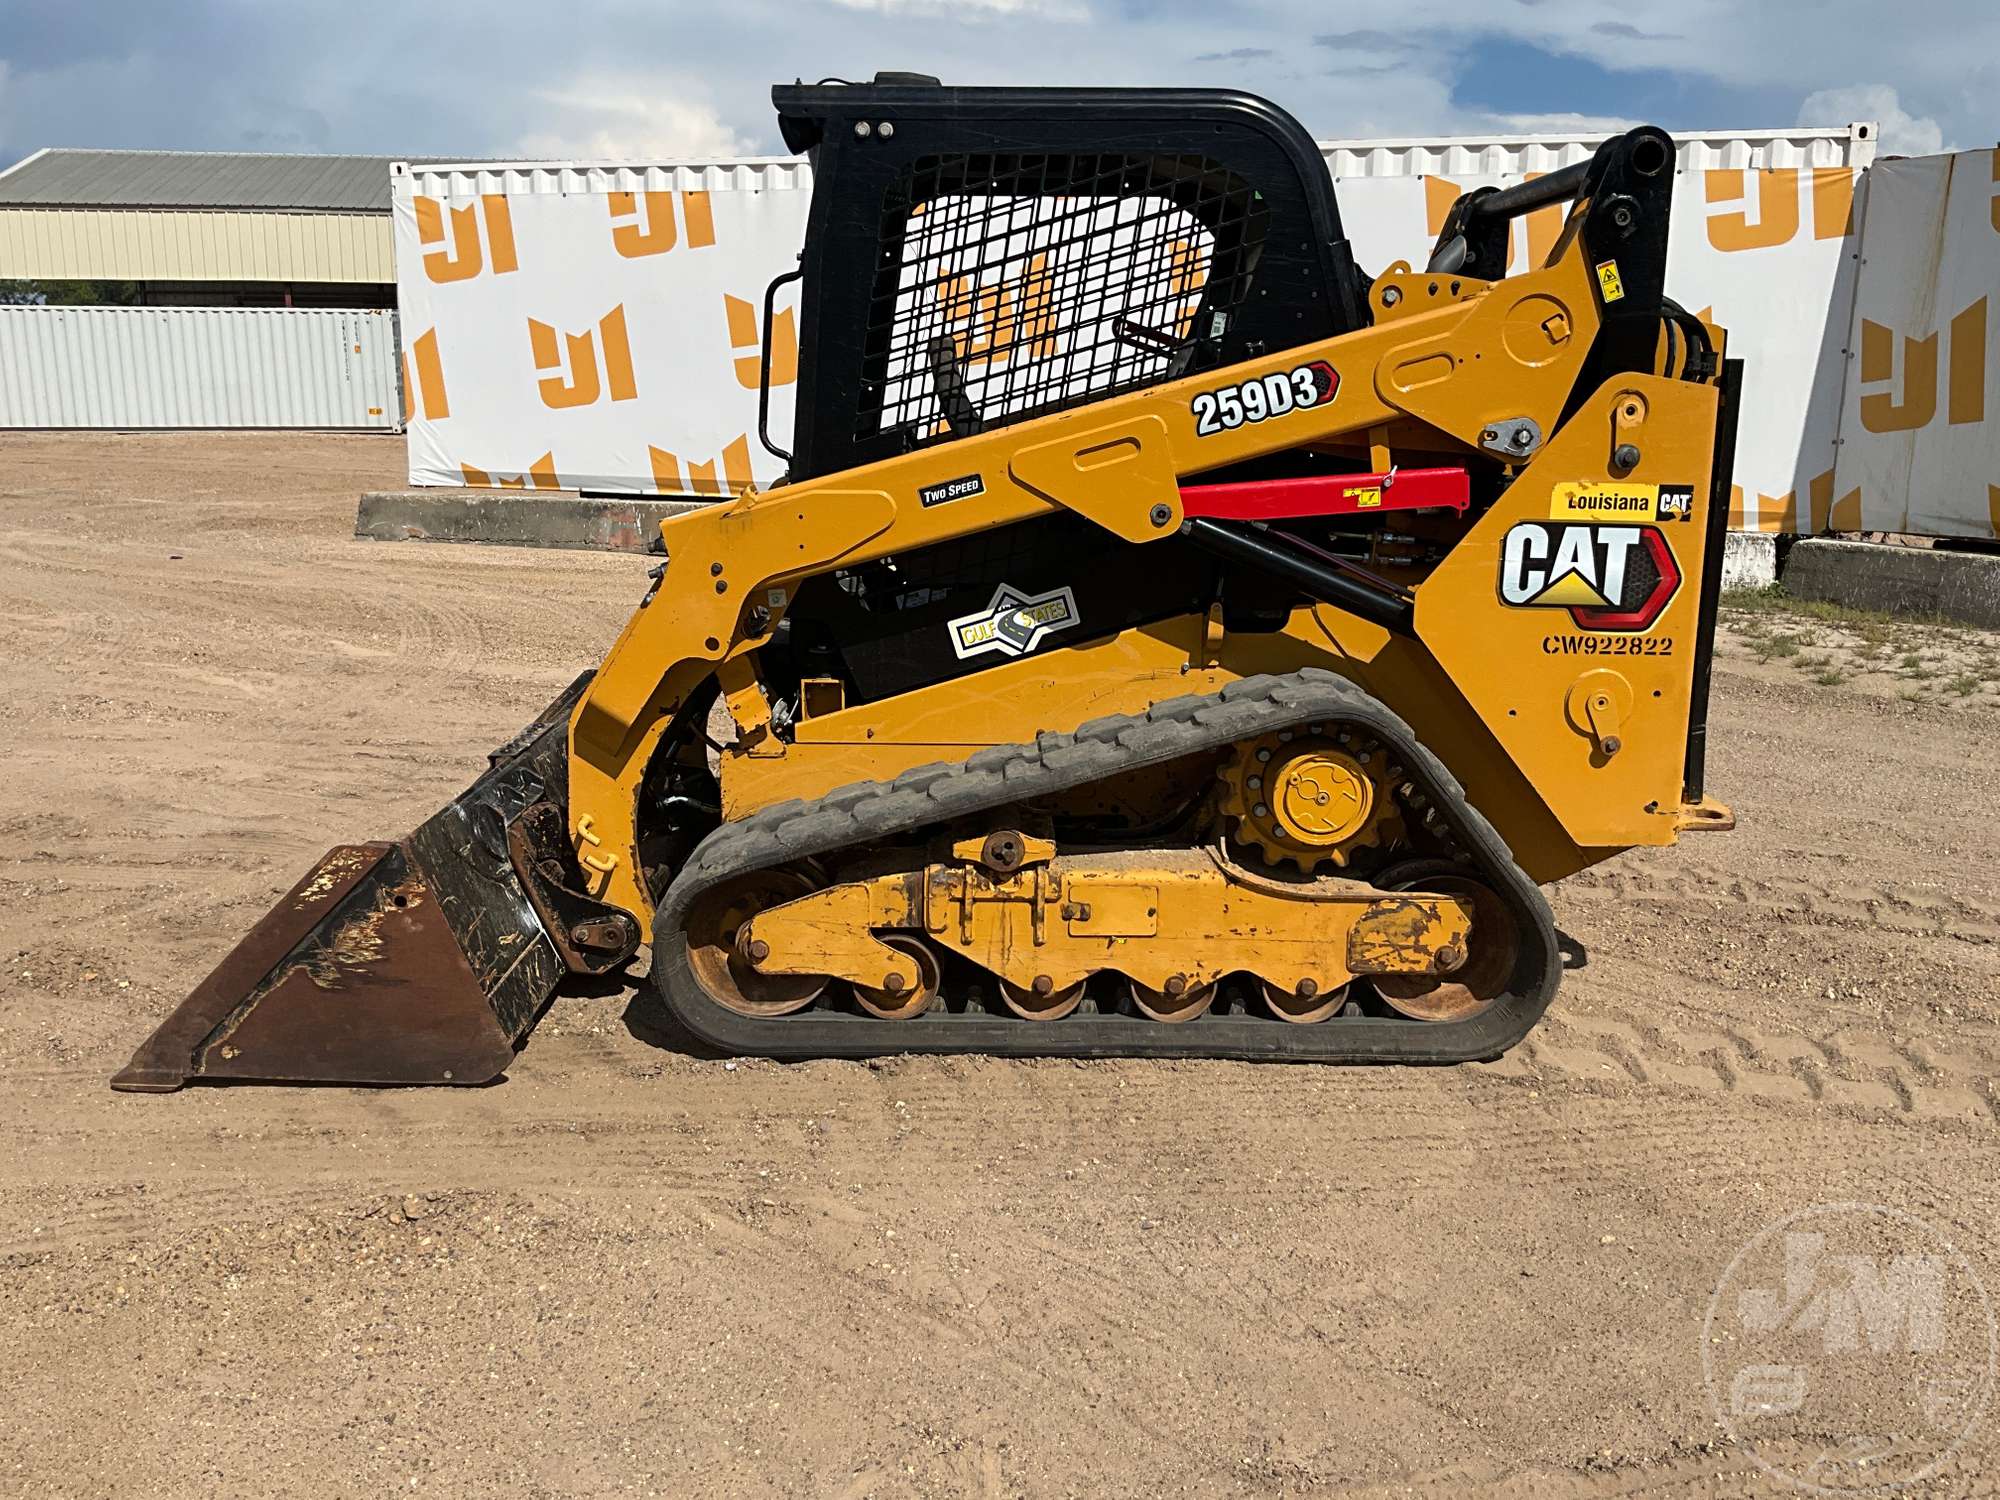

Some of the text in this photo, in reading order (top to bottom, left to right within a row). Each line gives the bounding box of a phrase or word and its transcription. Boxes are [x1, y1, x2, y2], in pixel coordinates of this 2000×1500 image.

[1193, 366, 1319, 435] 259D3
[1567, 493, 1649, 511] Louisiana
[1659, 493, 1690, 513] CAT
[1502, 523, 1641, 606] CAT
[1020, 601, 1067, 628] STATES
[961, 620, 997, 644] GULF
[1542, 635, 1674, 656] CW922822
